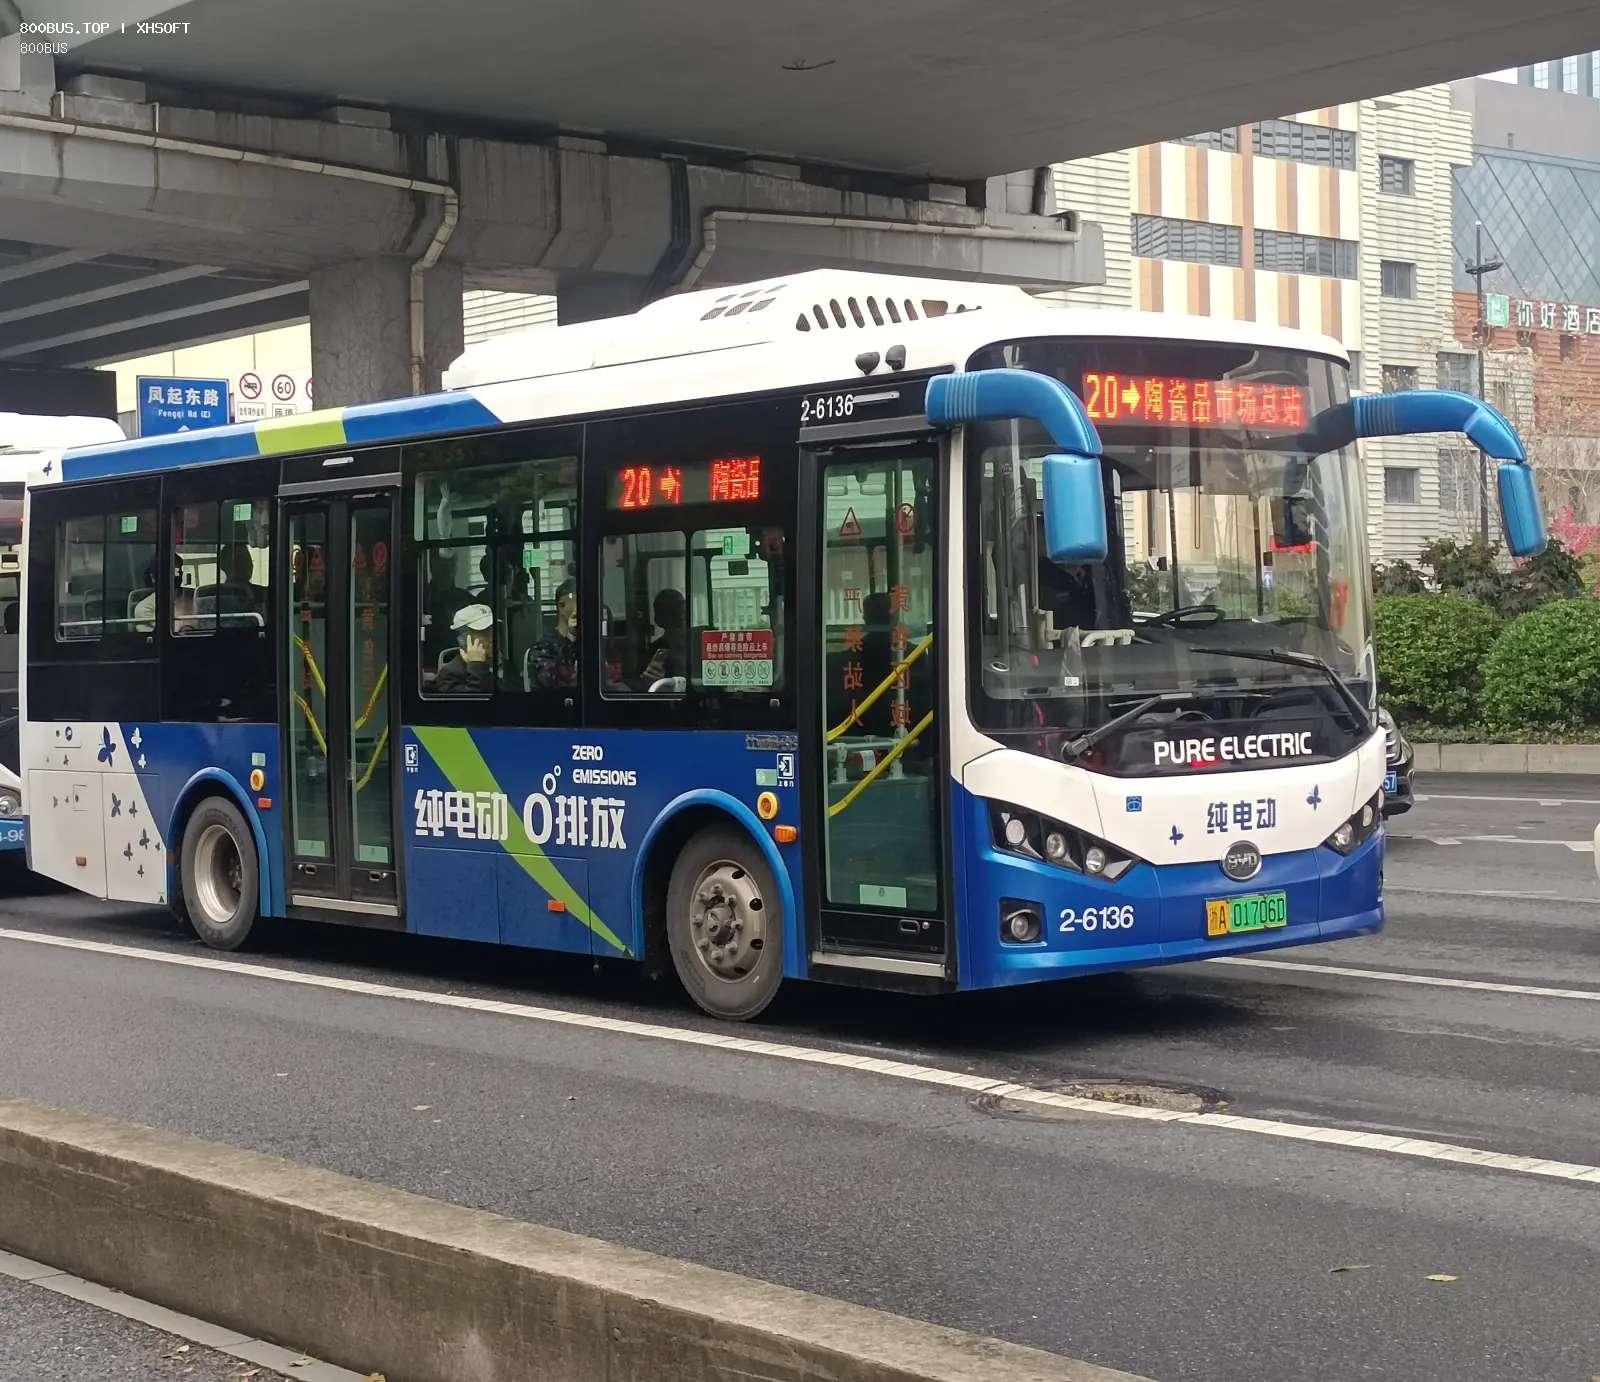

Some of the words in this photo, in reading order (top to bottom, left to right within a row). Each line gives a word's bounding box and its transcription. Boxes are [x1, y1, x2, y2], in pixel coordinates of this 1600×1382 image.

[1516, 299, 1600, 335] 你好酒店
[147, 386, 220, 407] 凤起东路
[276, 381, 292, 395] 60
[1085, 374, 1118, 419] 20
[1144, 377, 1303, 428] 陶瓷品市场总站
[158, 409, 184, 420] Fengqi
[187, 409, 198, 418] Rd
[200, 410, 211, 419] (E)
[800, 393, 854, 422] 2-6136
[623, 466, 651, 507] 20
[572, 745, 604, 761] ZERO
[1154, 737, 1216, 766] PURE
[1219, 730, 1313, 762] ELECTRIC
[572, 768, 637, 787] EMISSIONS
[414, 789, 508, 841] 纯电动
[1206, 797, 1277, 835] 纯电动
[1227, 852, 1258, 870] BYD
[1059, 905, 1135, 932] 2-6136
